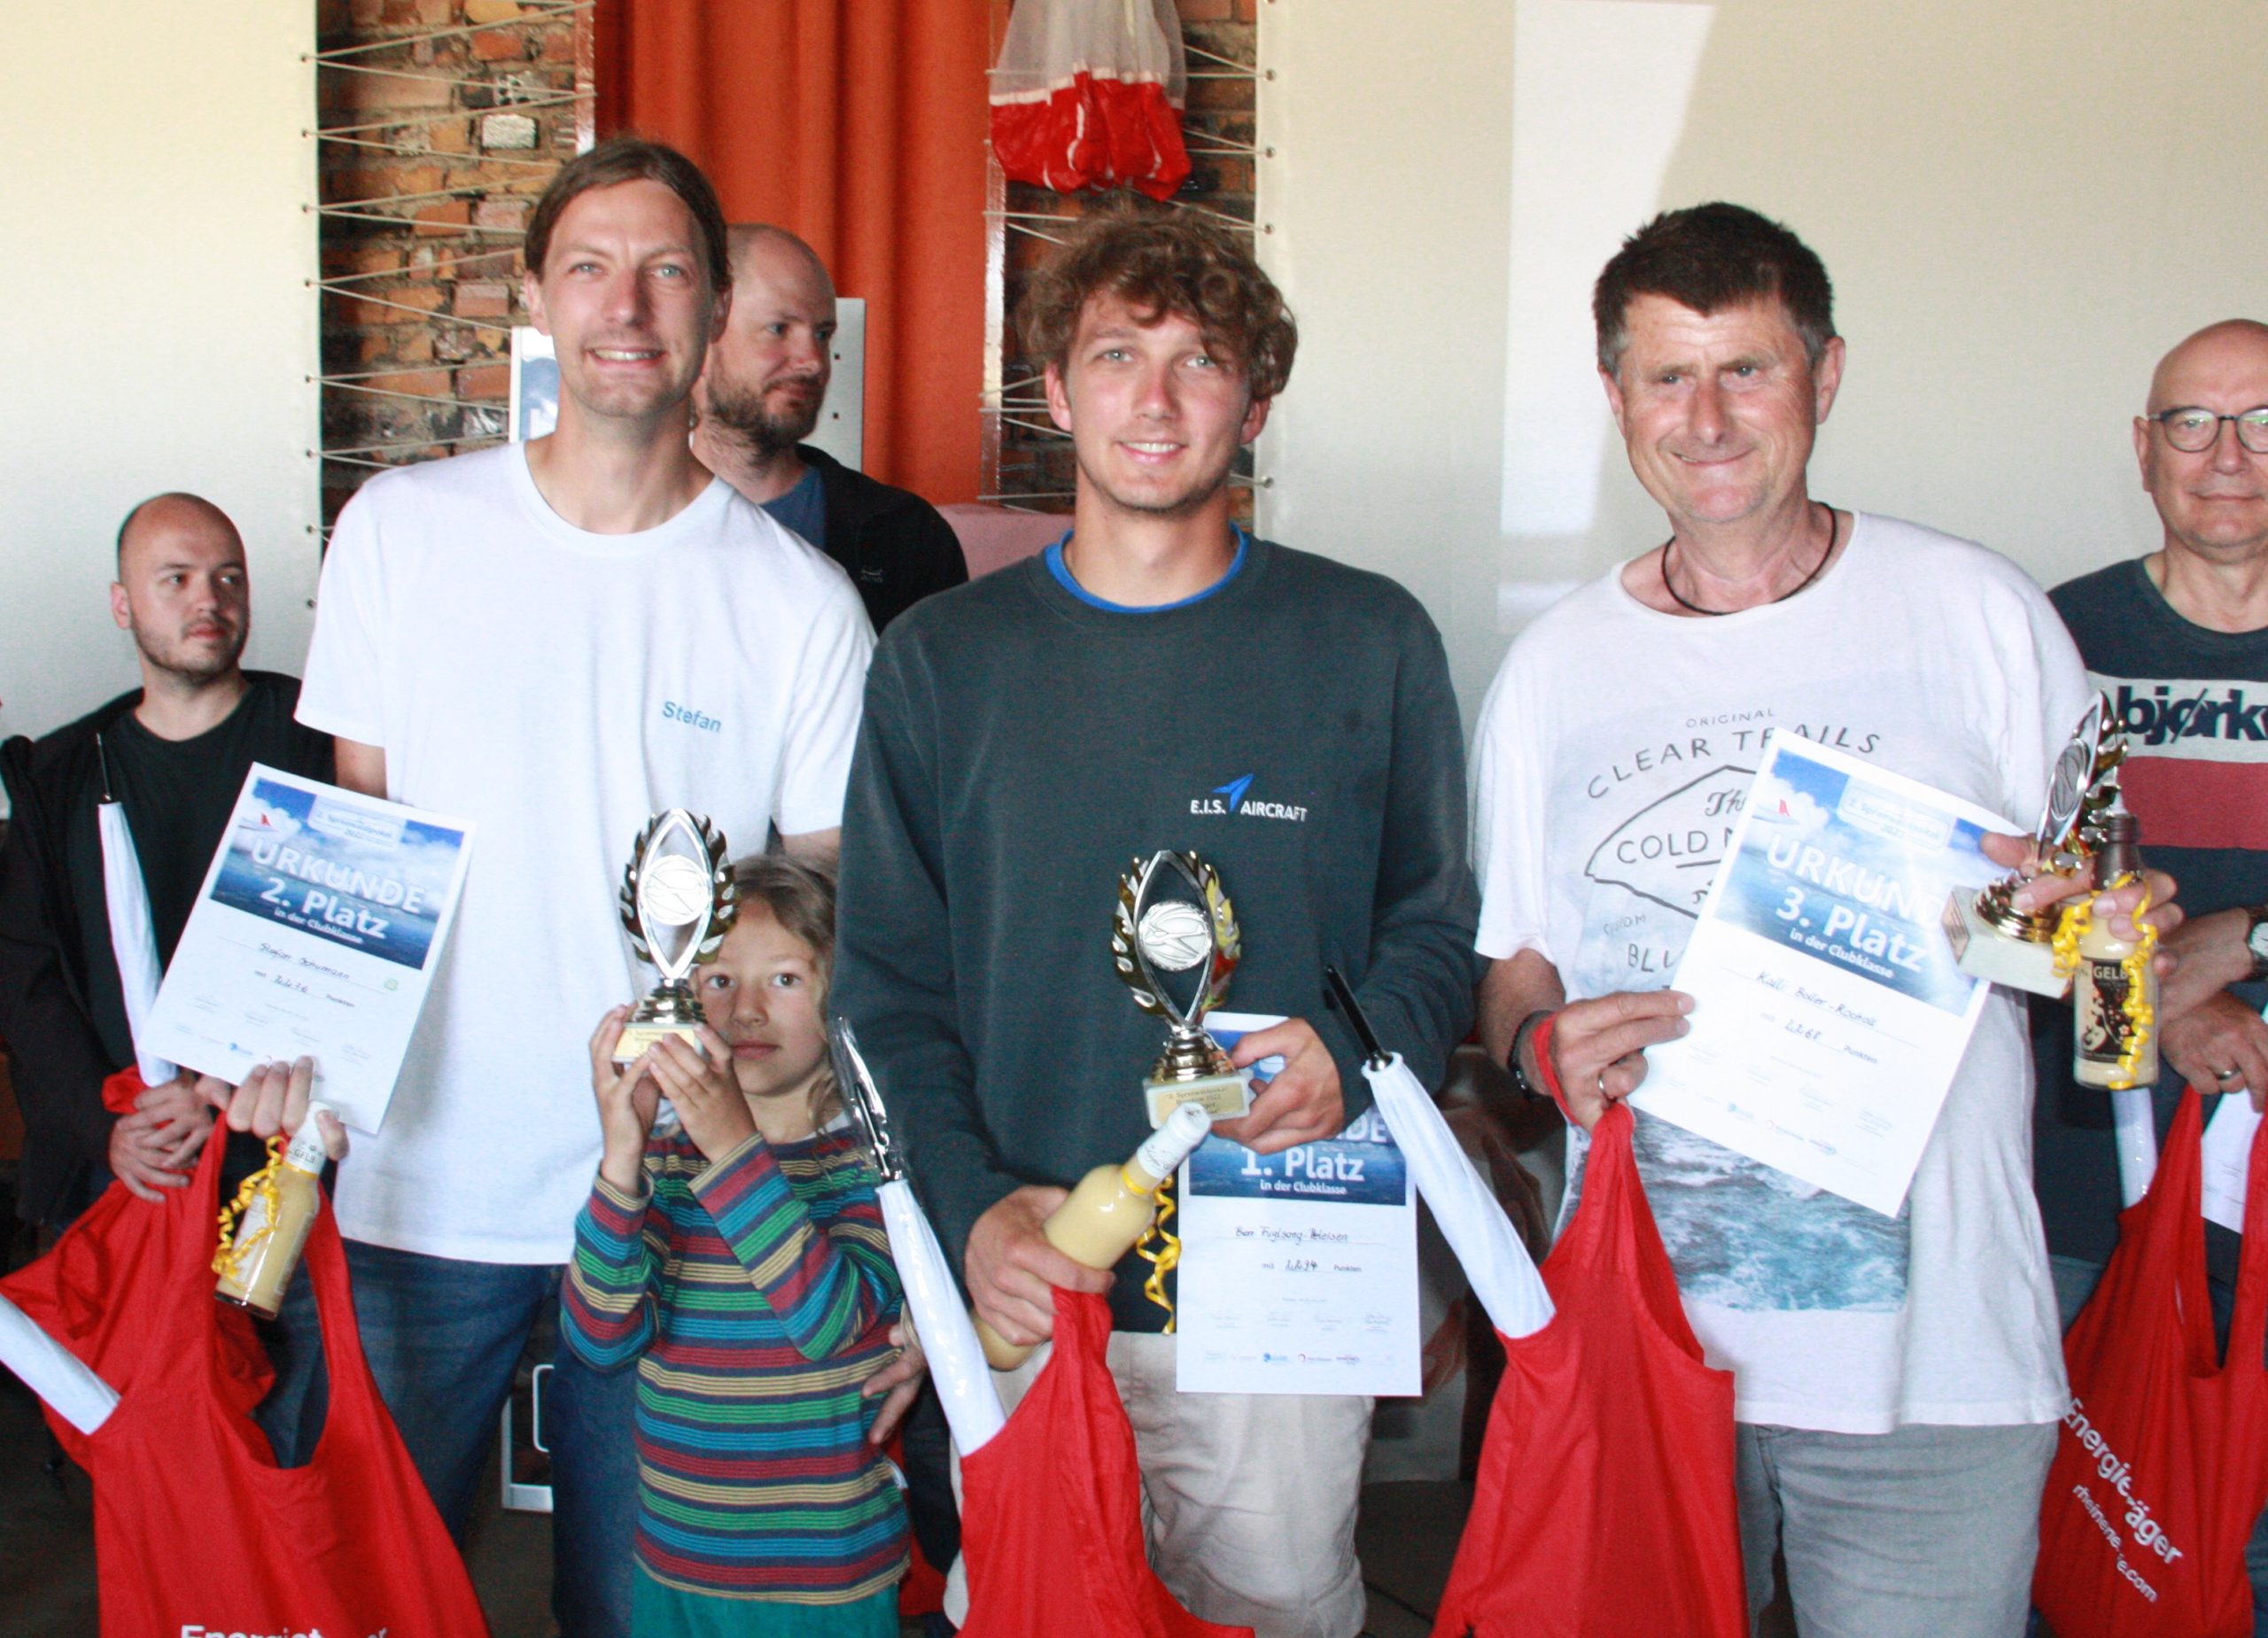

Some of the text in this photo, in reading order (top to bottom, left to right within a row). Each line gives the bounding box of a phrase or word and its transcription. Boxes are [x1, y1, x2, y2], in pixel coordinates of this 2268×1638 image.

[663, 701, 722, 733] Stefan
[1686, 708, 1776, 728] ORIGINAL
[1588, 738, 1712, 799] CLEAR
[1190, 799, 1308, 822] E.I.S. AIRCRAFT
[1705, 788, 1748, 817] Th
[1617, 829, 1709, 864] COLD
[252, 838, 426, 913] URKUNDE
[260, 877, 389, 939] 2. Platz
[274, 906, 287, 919] in
[287, 912, 307, 927] der
[1775, 886, 1811, 928] 3.
[1822, 904, 1929, 973] Platz
[1627, 943, 1683, 973] BLU
[1790, 928, 1895, 980] in der Clubklasse
[1241, 1145, 1365, 1182] 1. Platz
[1260, 1178, 1348, 1195] in der Clubklasse
[1333, 1264, 1362, 1273] Punkten
[2064, 1397, 2184, 1564] Energieäger
